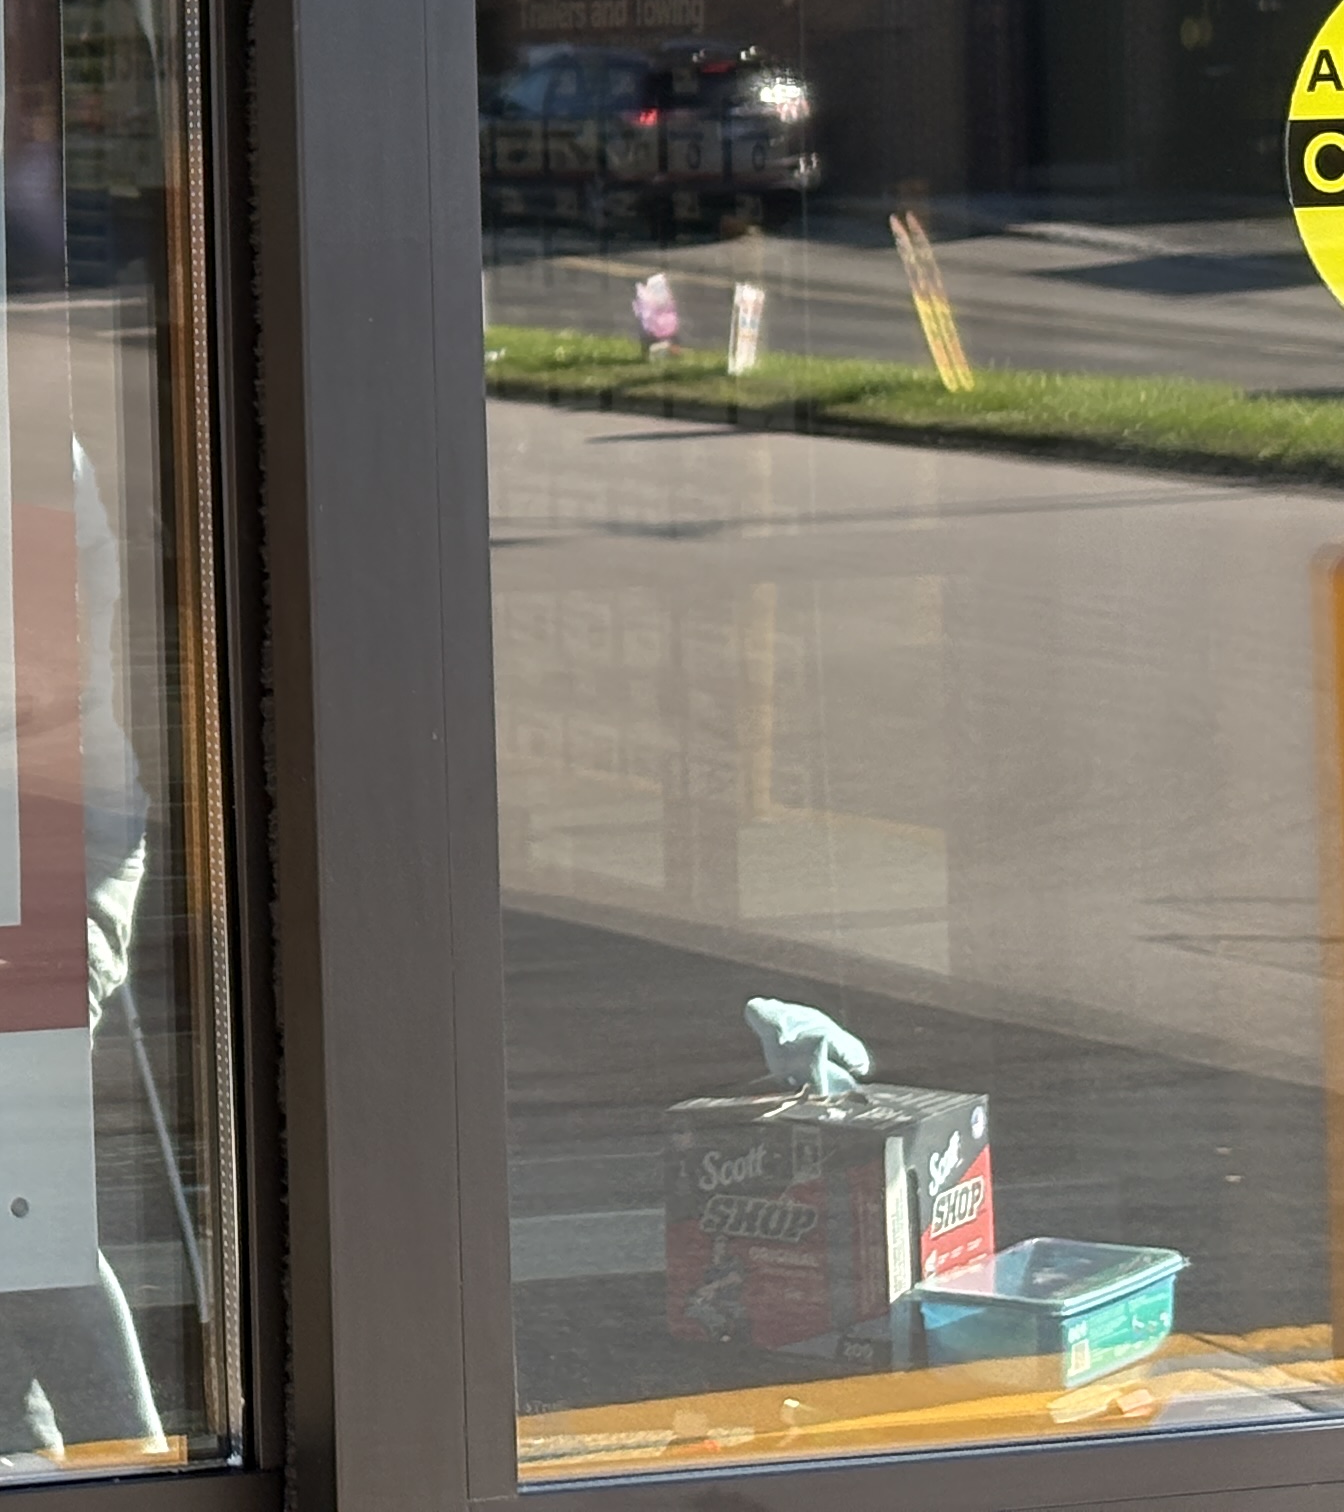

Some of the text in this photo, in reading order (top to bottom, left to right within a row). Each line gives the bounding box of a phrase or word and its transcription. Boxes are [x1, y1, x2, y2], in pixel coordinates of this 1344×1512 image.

[698, 1143, 768, 1191] Scott
[700, 1194, 817, 1243] SHOP
[930, 1175, 985, 1239] SHOP
